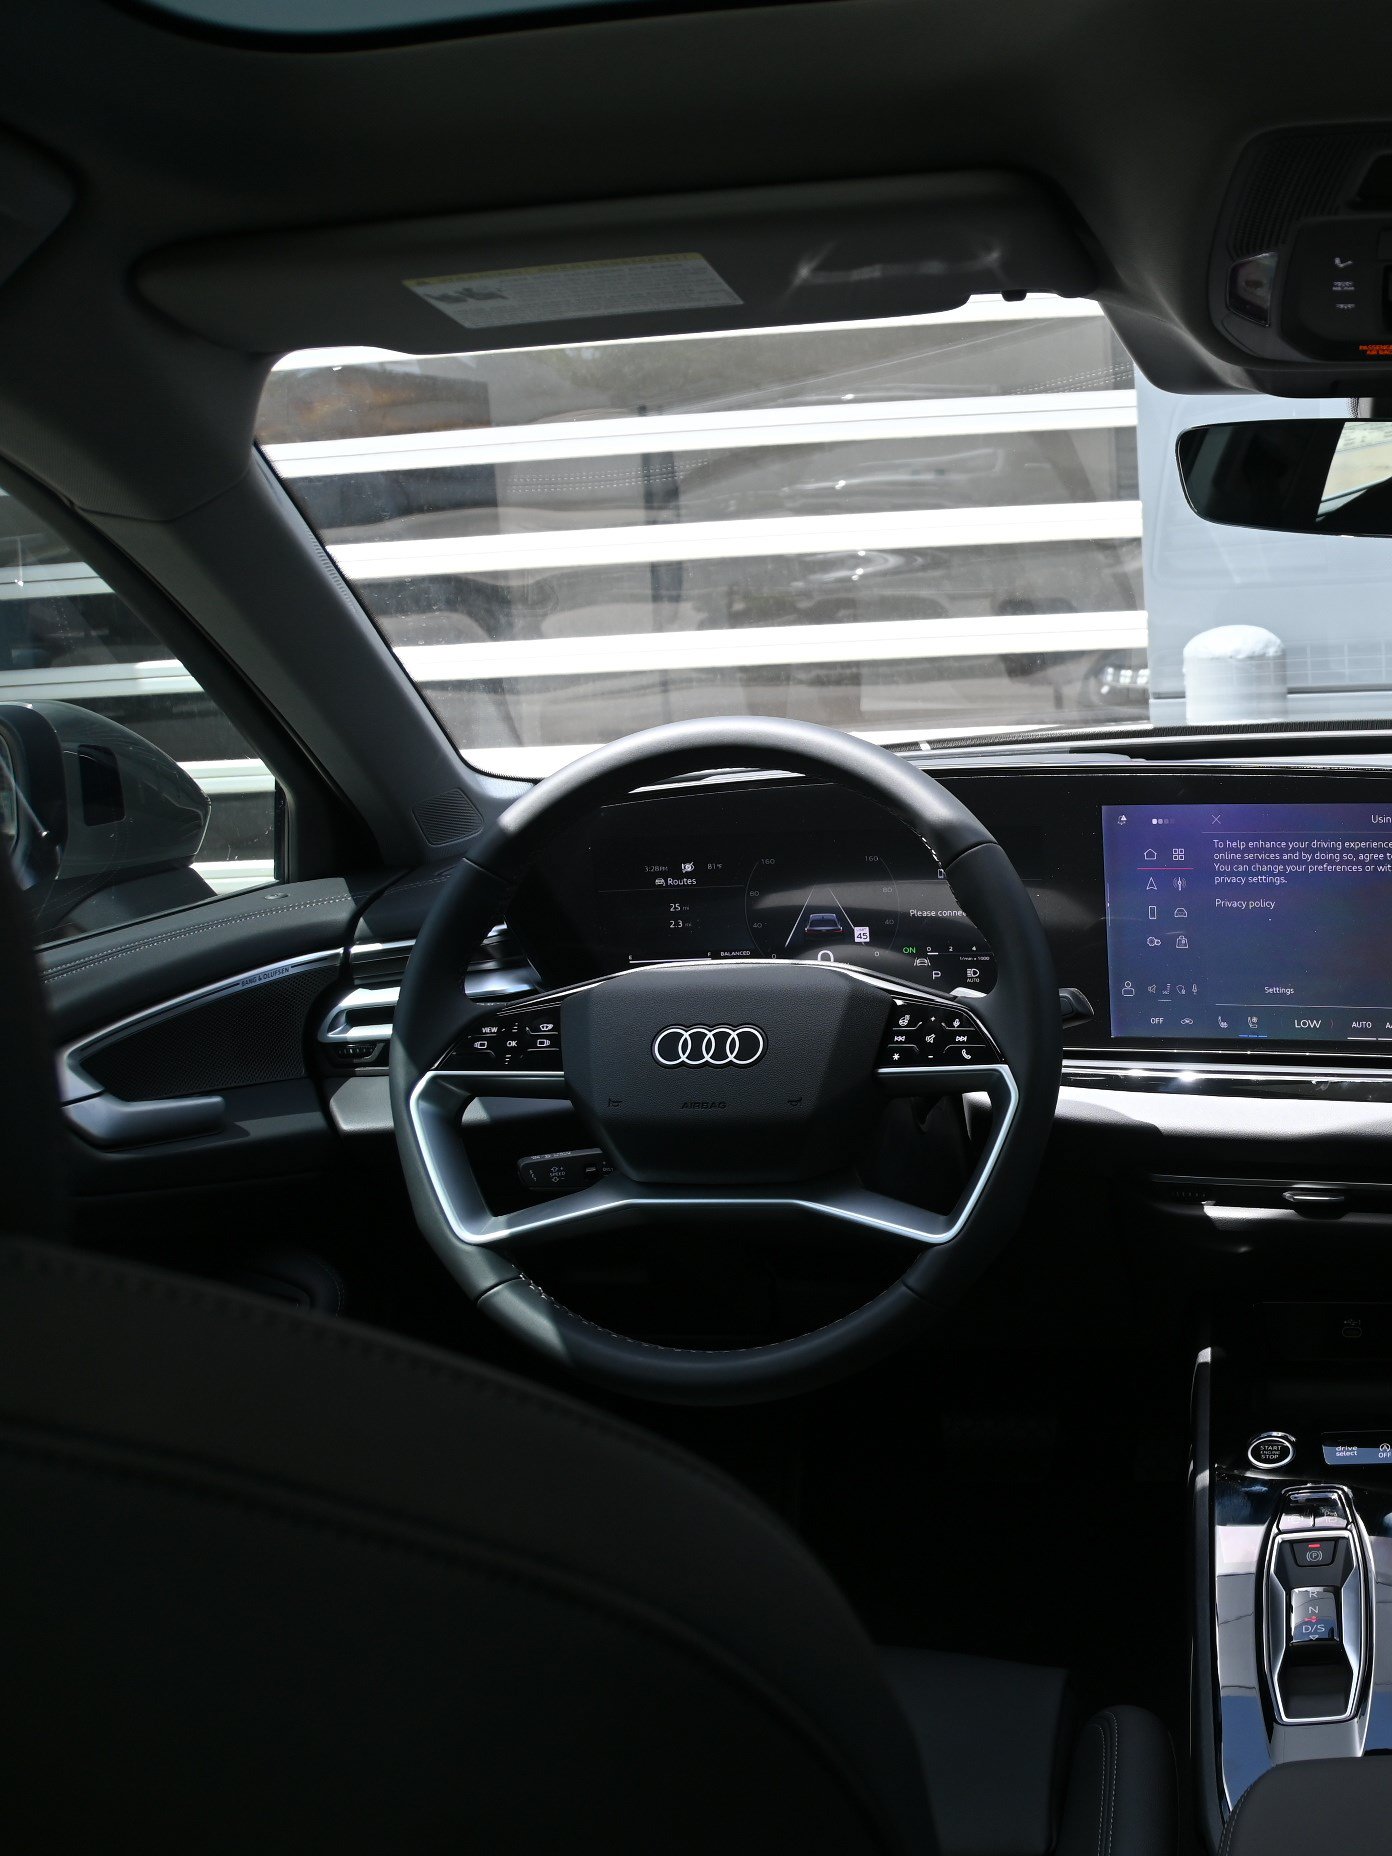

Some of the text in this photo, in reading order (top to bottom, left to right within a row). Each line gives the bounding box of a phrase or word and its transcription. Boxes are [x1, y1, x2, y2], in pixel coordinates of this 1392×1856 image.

[1213, 840, 1224, 848] To
[1226, 839, 1246, 850] help
[1248, 840, 1286, 848] enhance
[1288, 841, 1308, 850] your
[1311, 840, 1342, 850] driving
[1213, 852, 1242, 860] online
[1243, 852, 1280, 860] services
[1282, 852, 1299, 860] and
[1301, 852, 1312, 862] by
[1314, 852, 1340, 862] doing
[1342, 853, 1356, 861] so,
[1358, 853, 1384, 862] agree
[1213, 863, 1231, 872] You
[1233, 864, 1248, 872] can
[1251, 863, 1283, 874] change
[1285, 864, 1306, 874] your
[1308, 863, 1362, 874] preferences
[667, 877, 697, 886] Routes
[1214, 875, 1287, 885] privacy settings.
[1215, 899, 1276, 909] Privacy policy
[669, 920, 683, 928] 2.3
[263, 967, 289, 979] OLUFSEN
[932, 971, 941, 980] P
[1264, 987, 1294, 995] Settings
[1295, 1019, 1322, 1028] LOW
[1351, 1021, 1372, 1029] AUTO
[1309, 1590, 1318, 1598] R
[1302, 1625, 1325, 1633] D/S
